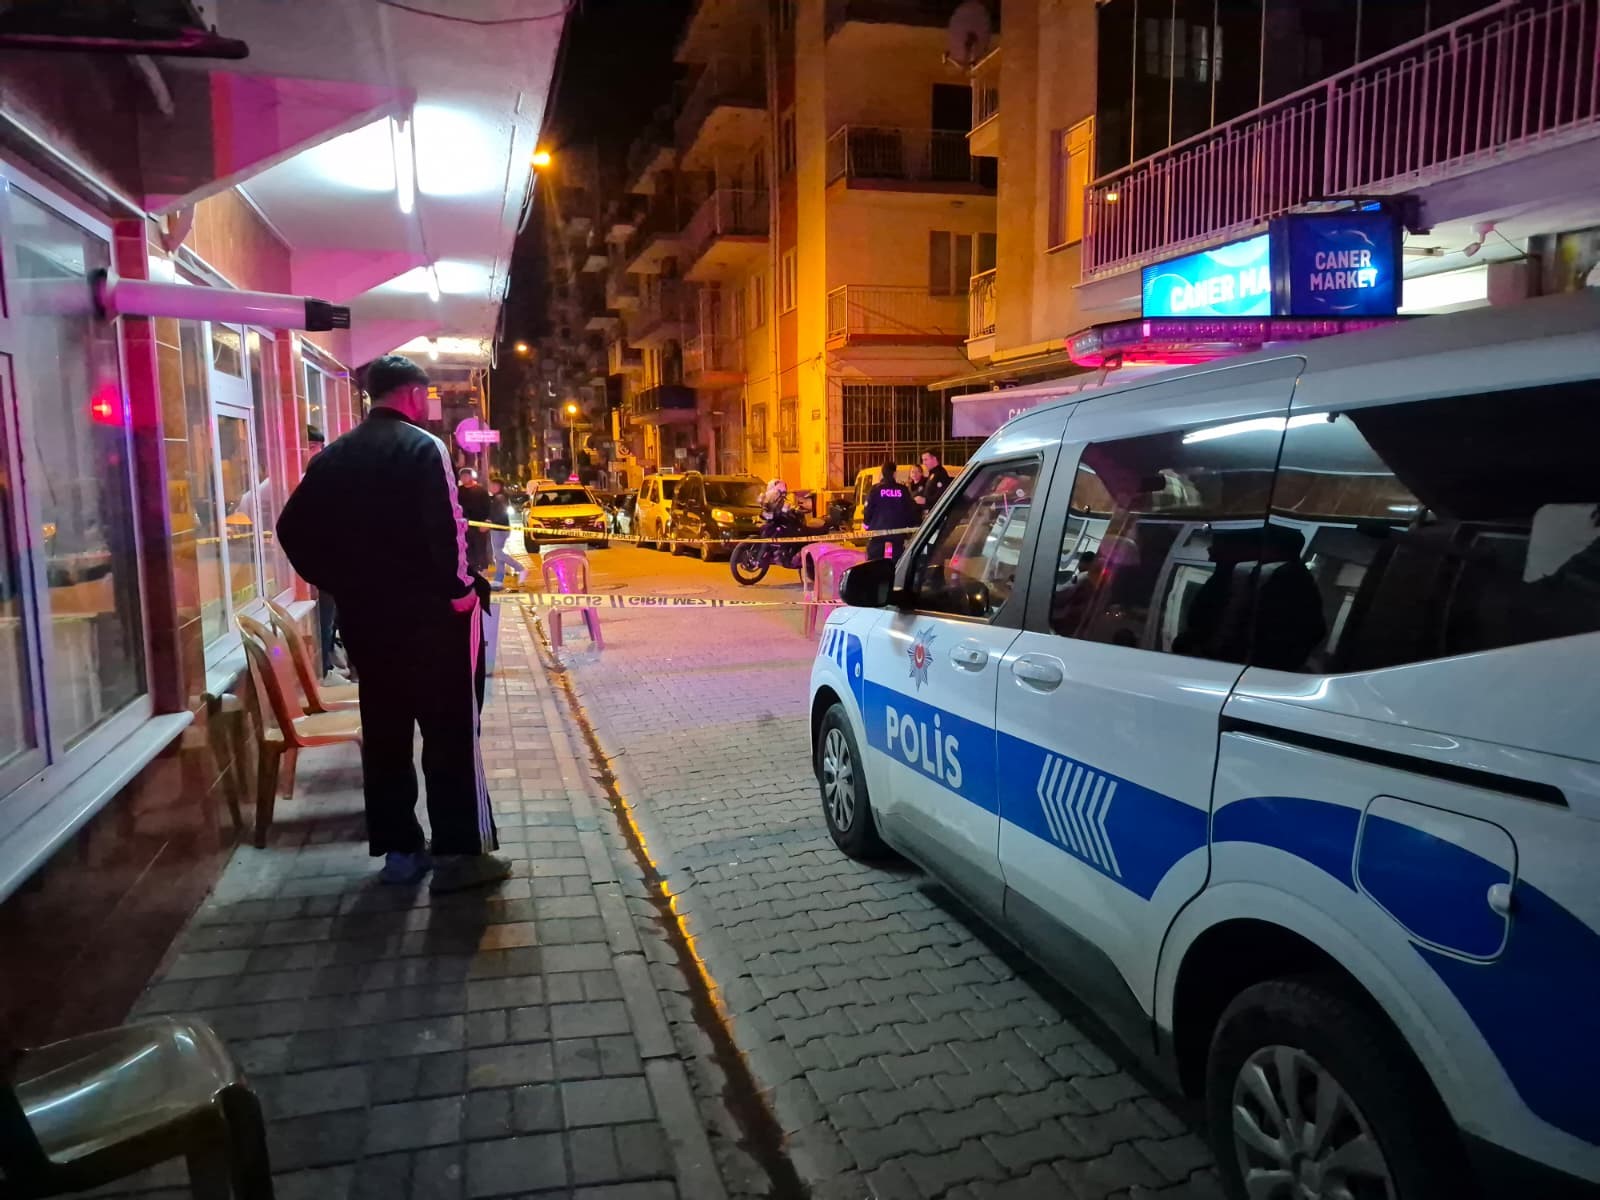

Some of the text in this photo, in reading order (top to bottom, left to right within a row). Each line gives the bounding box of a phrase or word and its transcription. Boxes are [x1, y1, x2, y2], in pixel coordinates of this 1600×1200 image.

[1316, 249, 1372, 270] CANER
[1171, 275, 1236, 311] CANER
[1310, 269, 1378, 291] MARKET
[885, 704, 963, 790] POLİS
